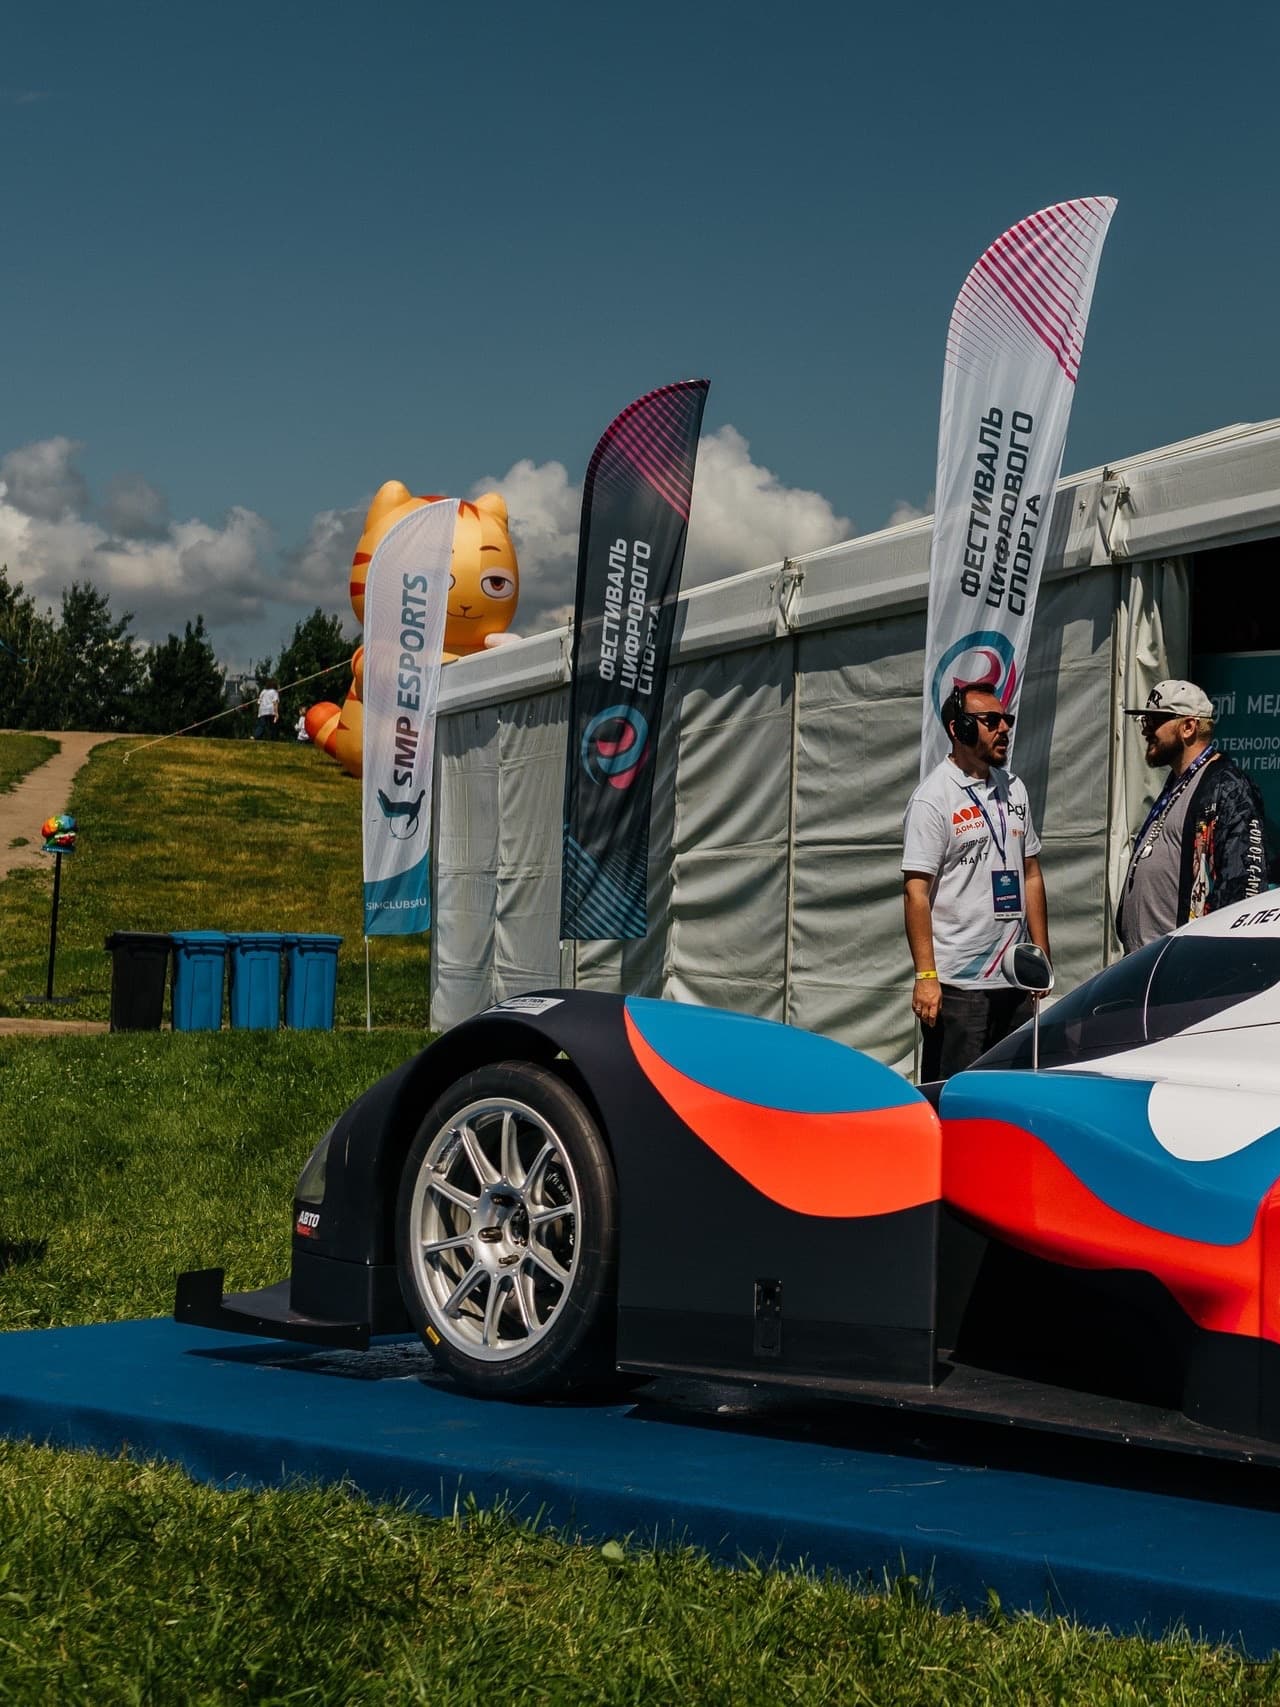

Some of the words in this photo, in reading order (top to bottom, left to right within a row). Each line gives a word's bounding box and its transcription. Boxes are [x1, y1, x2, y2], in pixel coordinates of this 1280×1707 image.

[960, 407, 1003, 598] ФЕСТИВАЛЬ
[985, 410, 1033, 609] ЦИФРОВОГО
[1007, 494, 1041, 617] СПОРТА
[397, 573, 428, 711] ESPORTS
[599, 538, 628, 682] ФЕСТИВАЛЬ
[620, 540, 651, 690] ЦИФРОВОГО
[637, 605, 662, 695] СПОРТА
[393, 716, 419, 788] SMP
[1242, 758, 1250, 770] И
[298, 1210, 320, 1228] АВТО
